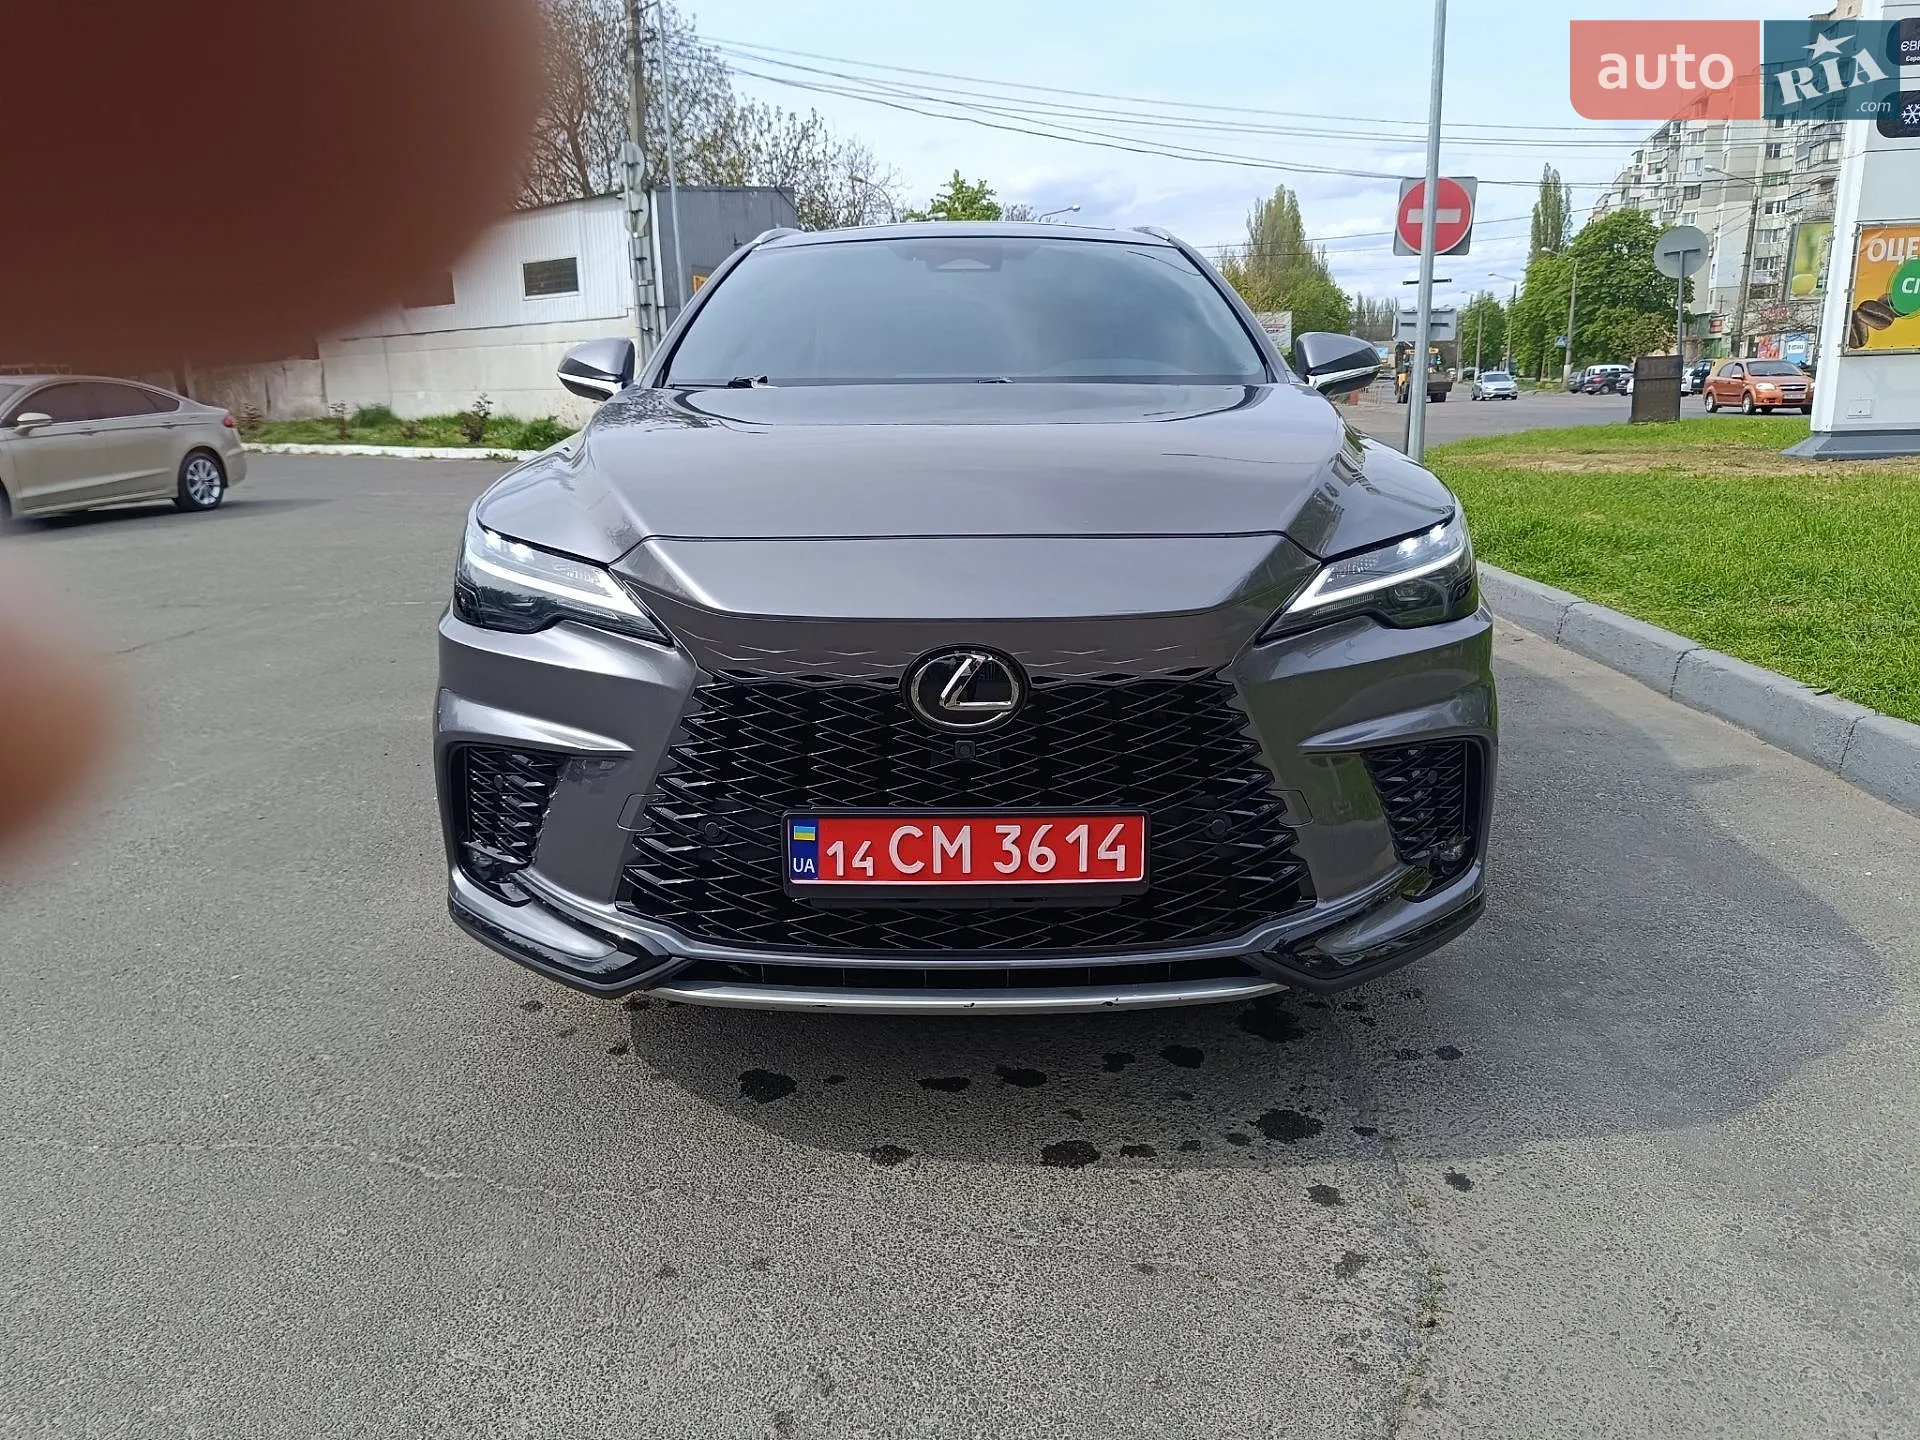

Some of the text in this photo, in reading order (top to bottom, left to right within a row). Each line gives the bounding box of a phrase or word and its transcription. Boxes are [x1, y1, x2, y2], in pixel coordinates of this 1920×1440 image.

[793, 857, 815, 873] UA
[826, 823, 1126, 877] 14 CM 3614
